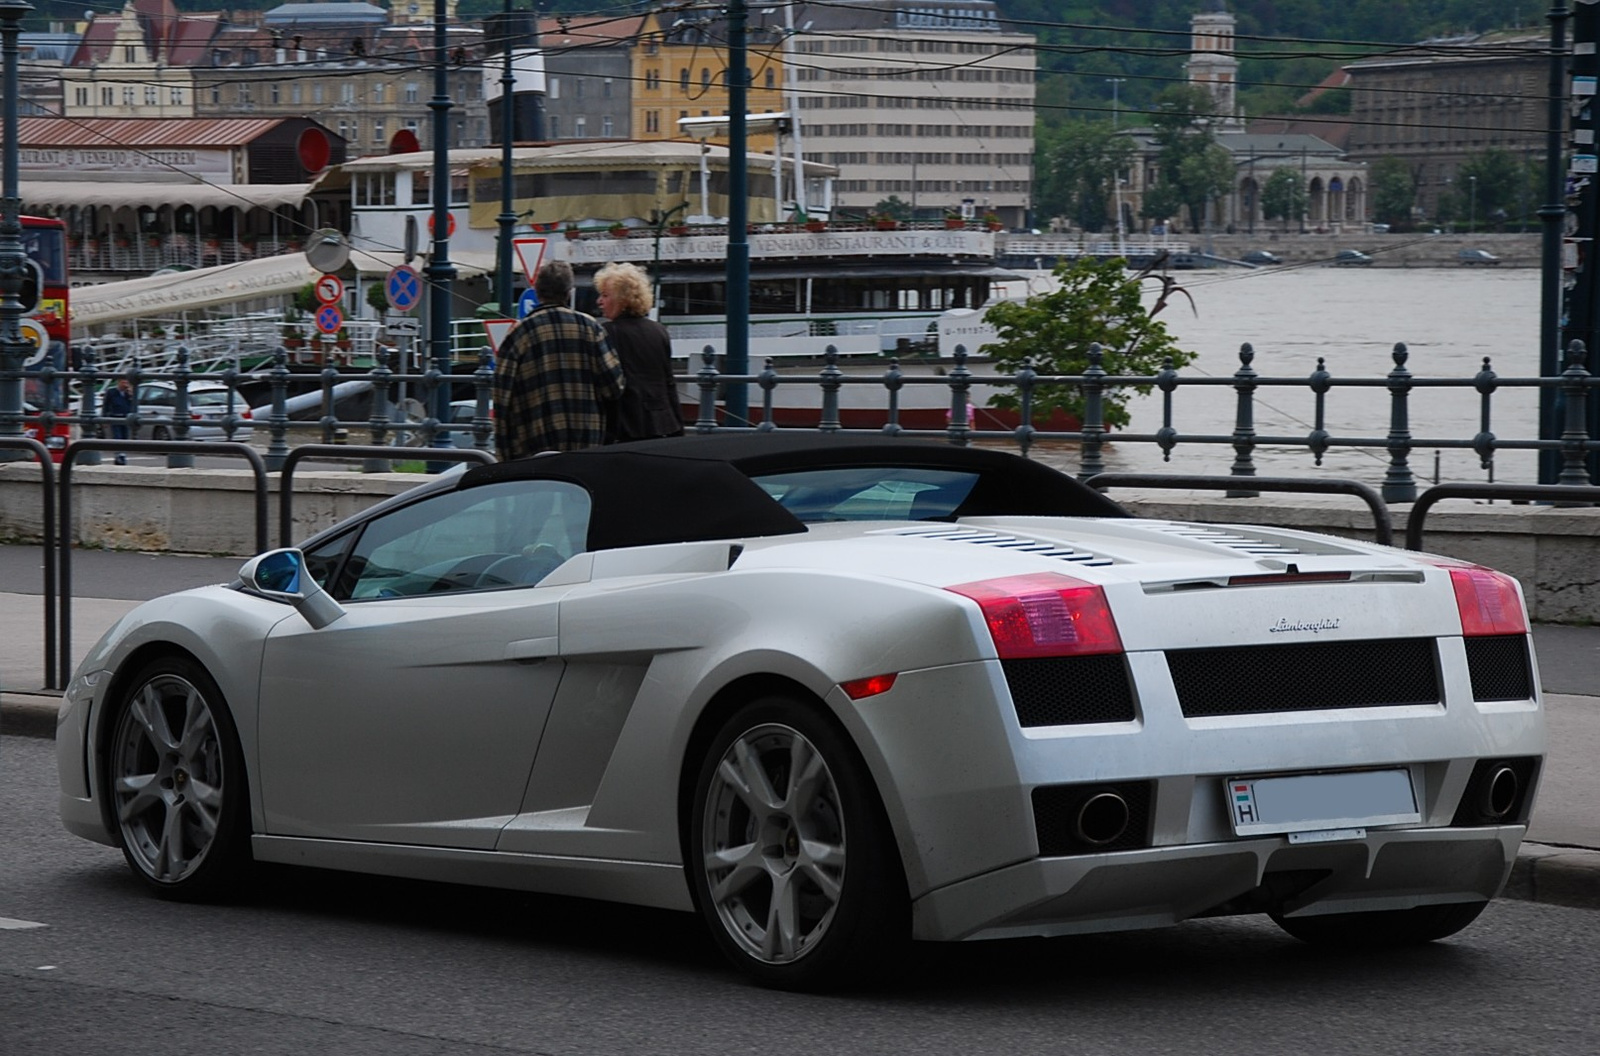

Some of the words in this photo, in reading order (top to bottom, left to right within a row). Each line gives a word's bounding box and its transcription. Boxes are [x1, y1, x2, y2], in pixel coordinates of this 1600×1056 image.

[816, 236, 917, 250] RESTAURANT
[921, 236, 933, 249] &
[1269, 618, 1340, 634] Lamborghini
[1238, 804, 1254, 823] H
